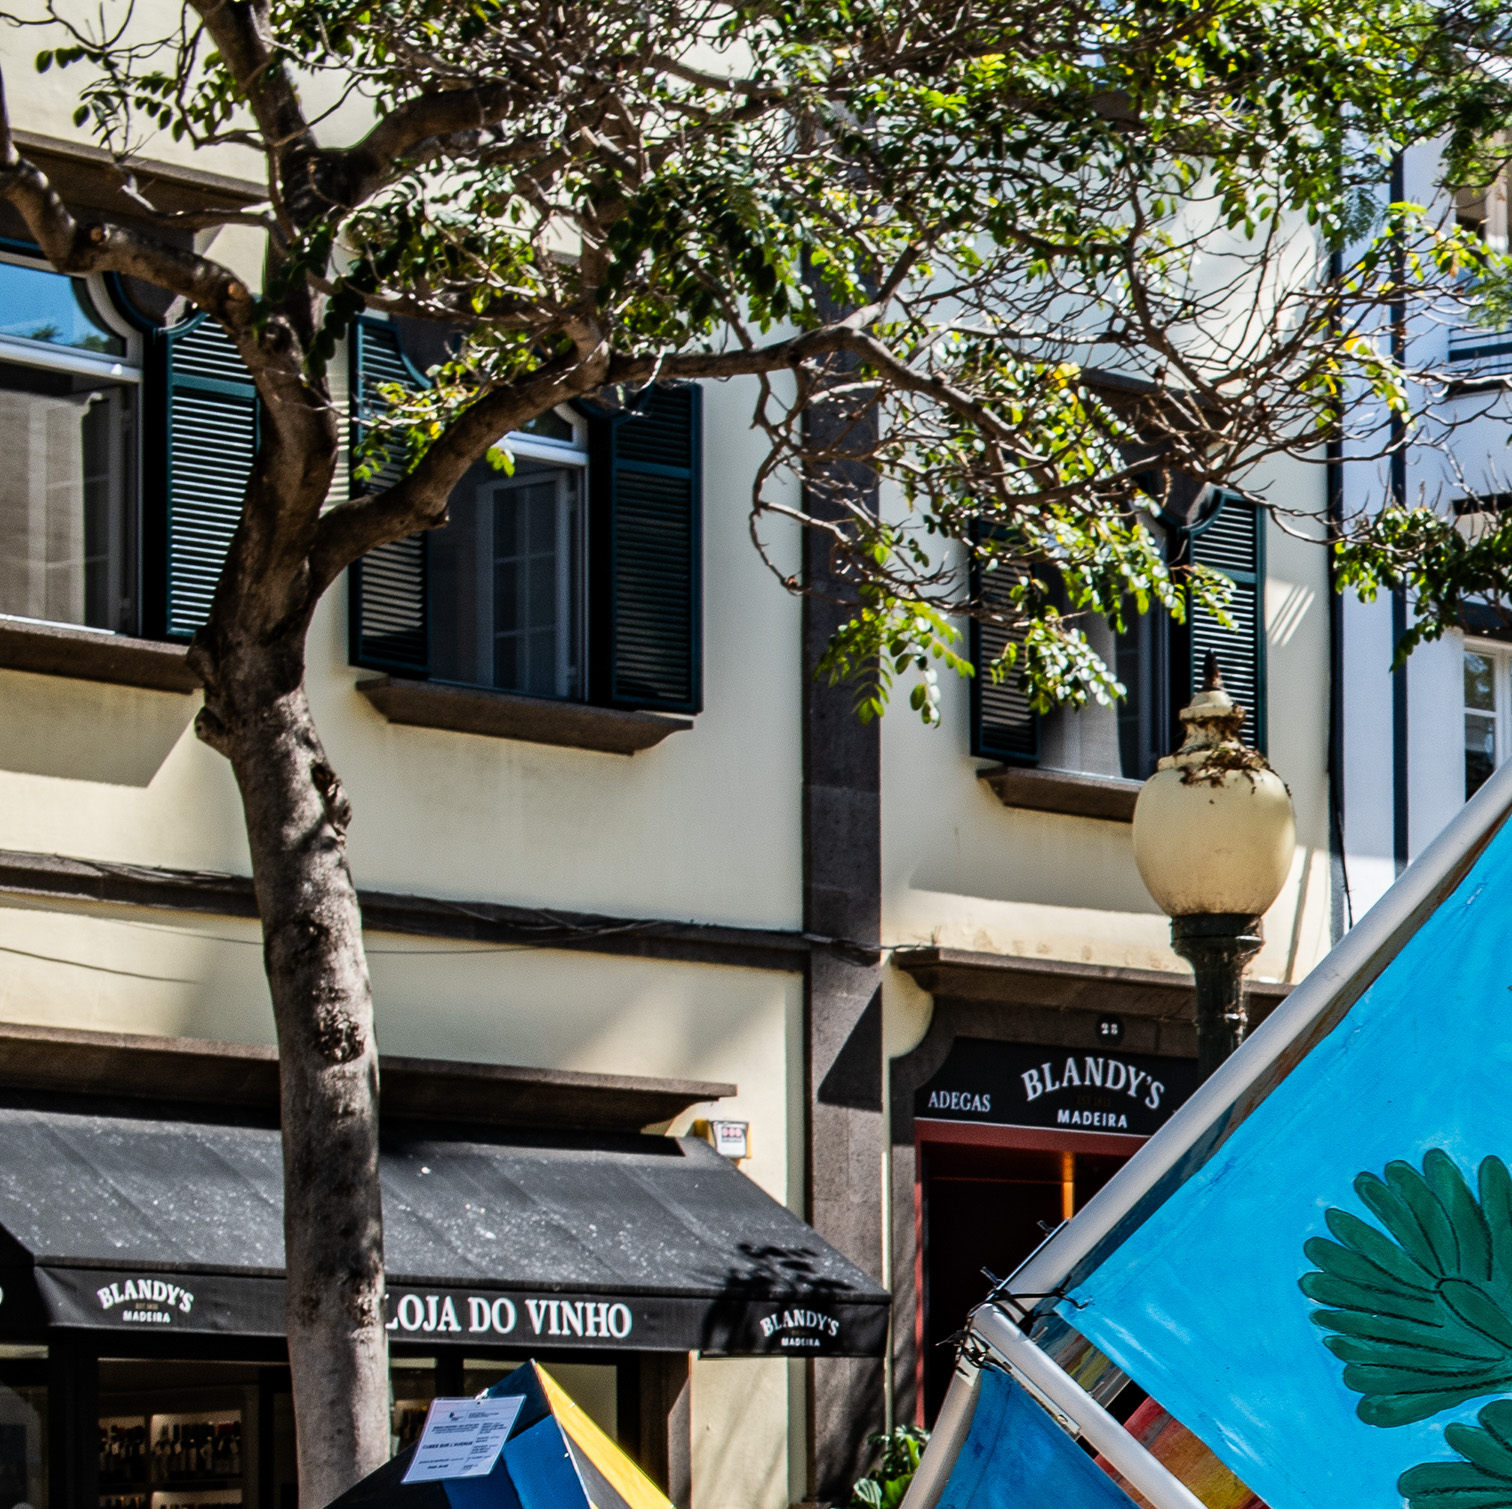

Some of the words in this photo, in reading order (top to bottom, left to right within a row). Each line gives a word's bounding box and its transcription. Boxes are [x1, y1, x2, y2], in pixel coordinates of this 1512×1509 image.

[1020, 1056, 1165, 1110] BLANDY'S
[928, 1090, 992, 1112] ADEGAS
[1057, 1108, 1128, 1129] MADEIRA
[97, 1278, 195, 1313] BLANDY'S
[123, 1310, 171, 1323] MADEIRA
[467, 1297, 517, 1334] DO
[524, 1298, 633, 1339] VINHO
[760, 1309, 839, 1337] BLANDY'S
[781, 1337, 821, 1347] MADEIRA
